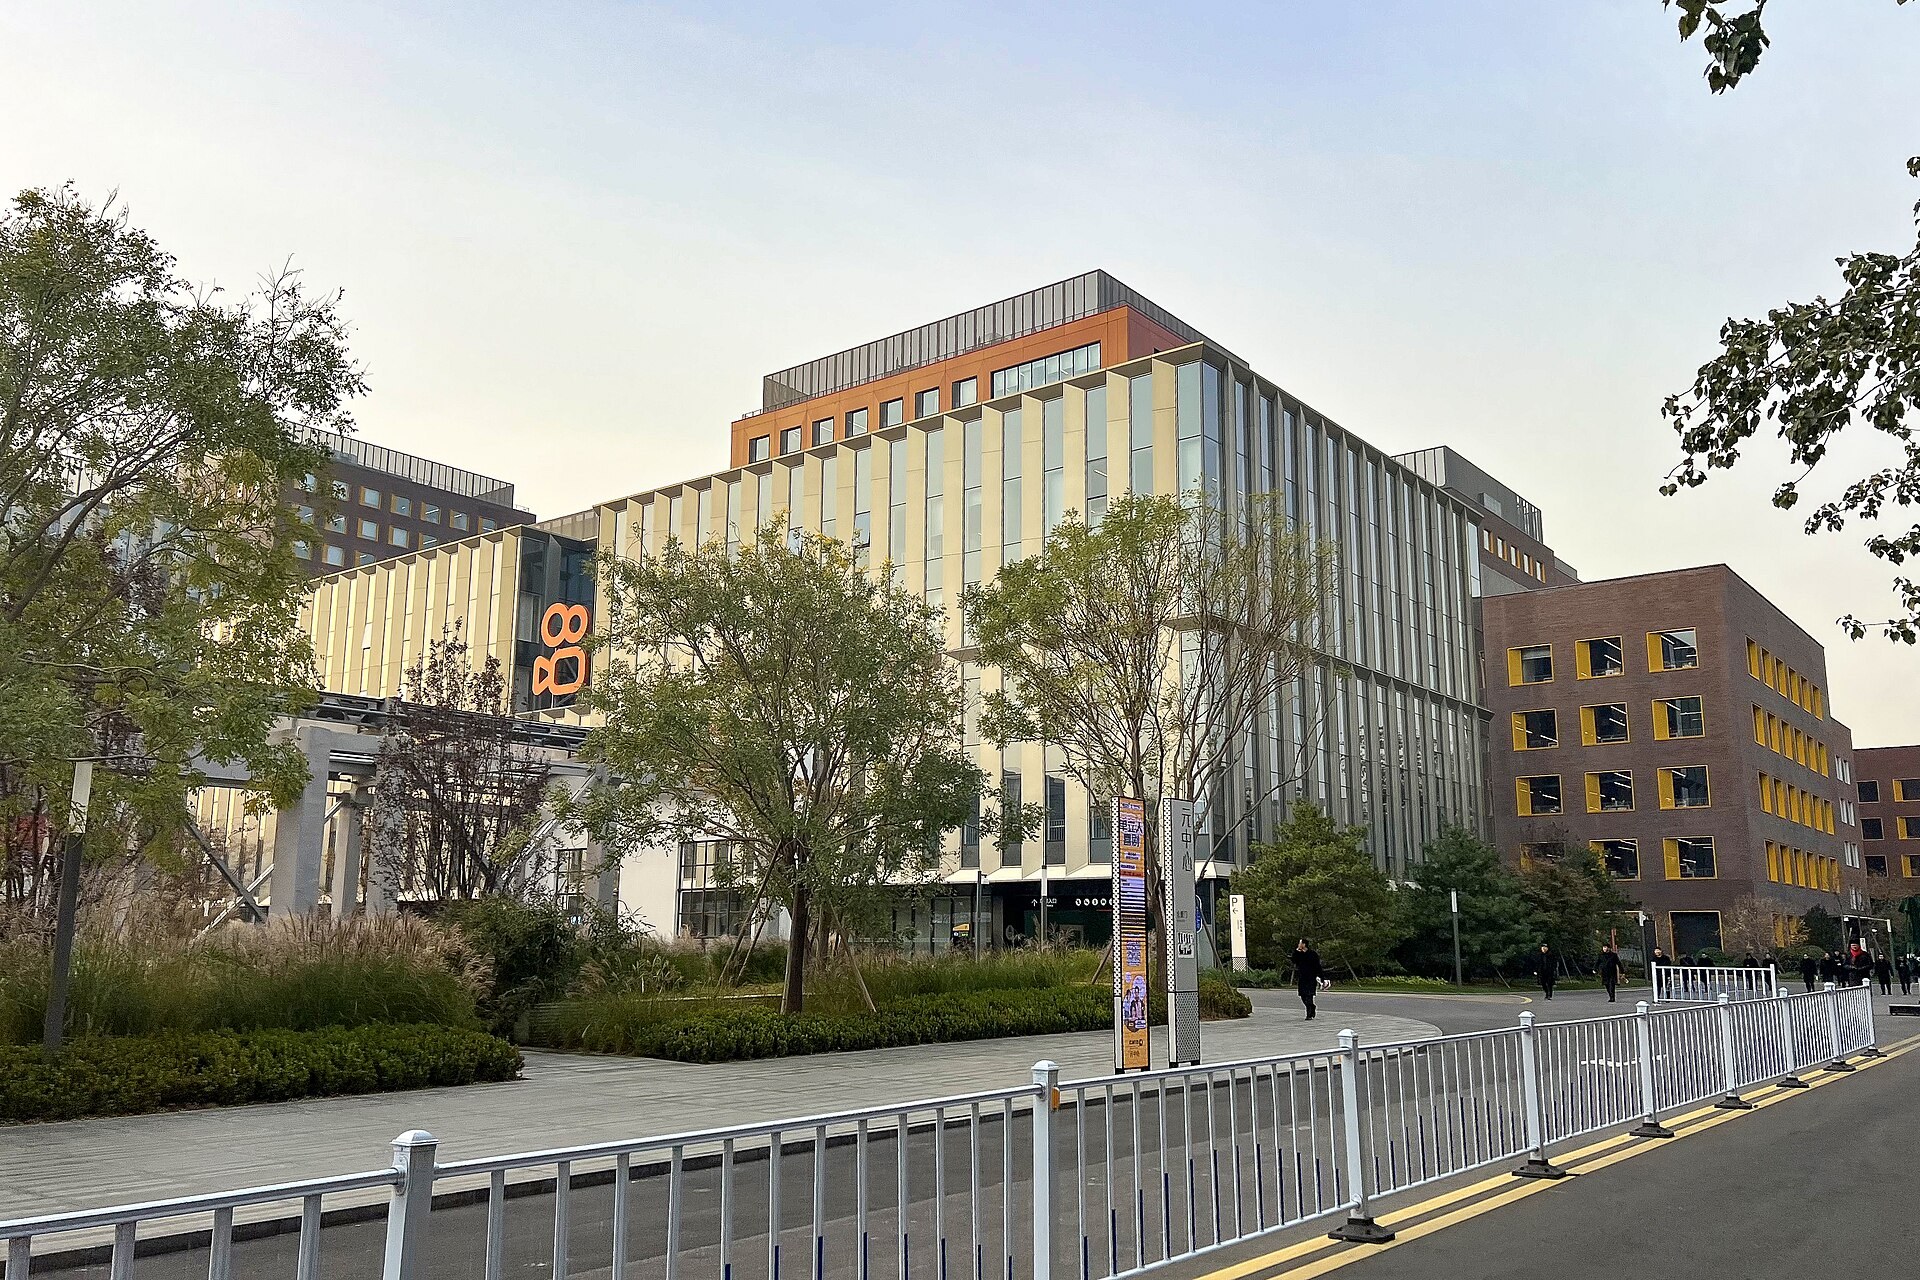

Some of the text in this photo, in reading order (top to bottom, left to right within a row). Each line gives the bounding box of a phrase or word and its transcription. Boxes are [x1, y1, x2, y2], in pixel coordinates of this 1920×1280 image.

[1181, 808, 1193, 872] 元中心
[1231, 897, 1238, 907] P
